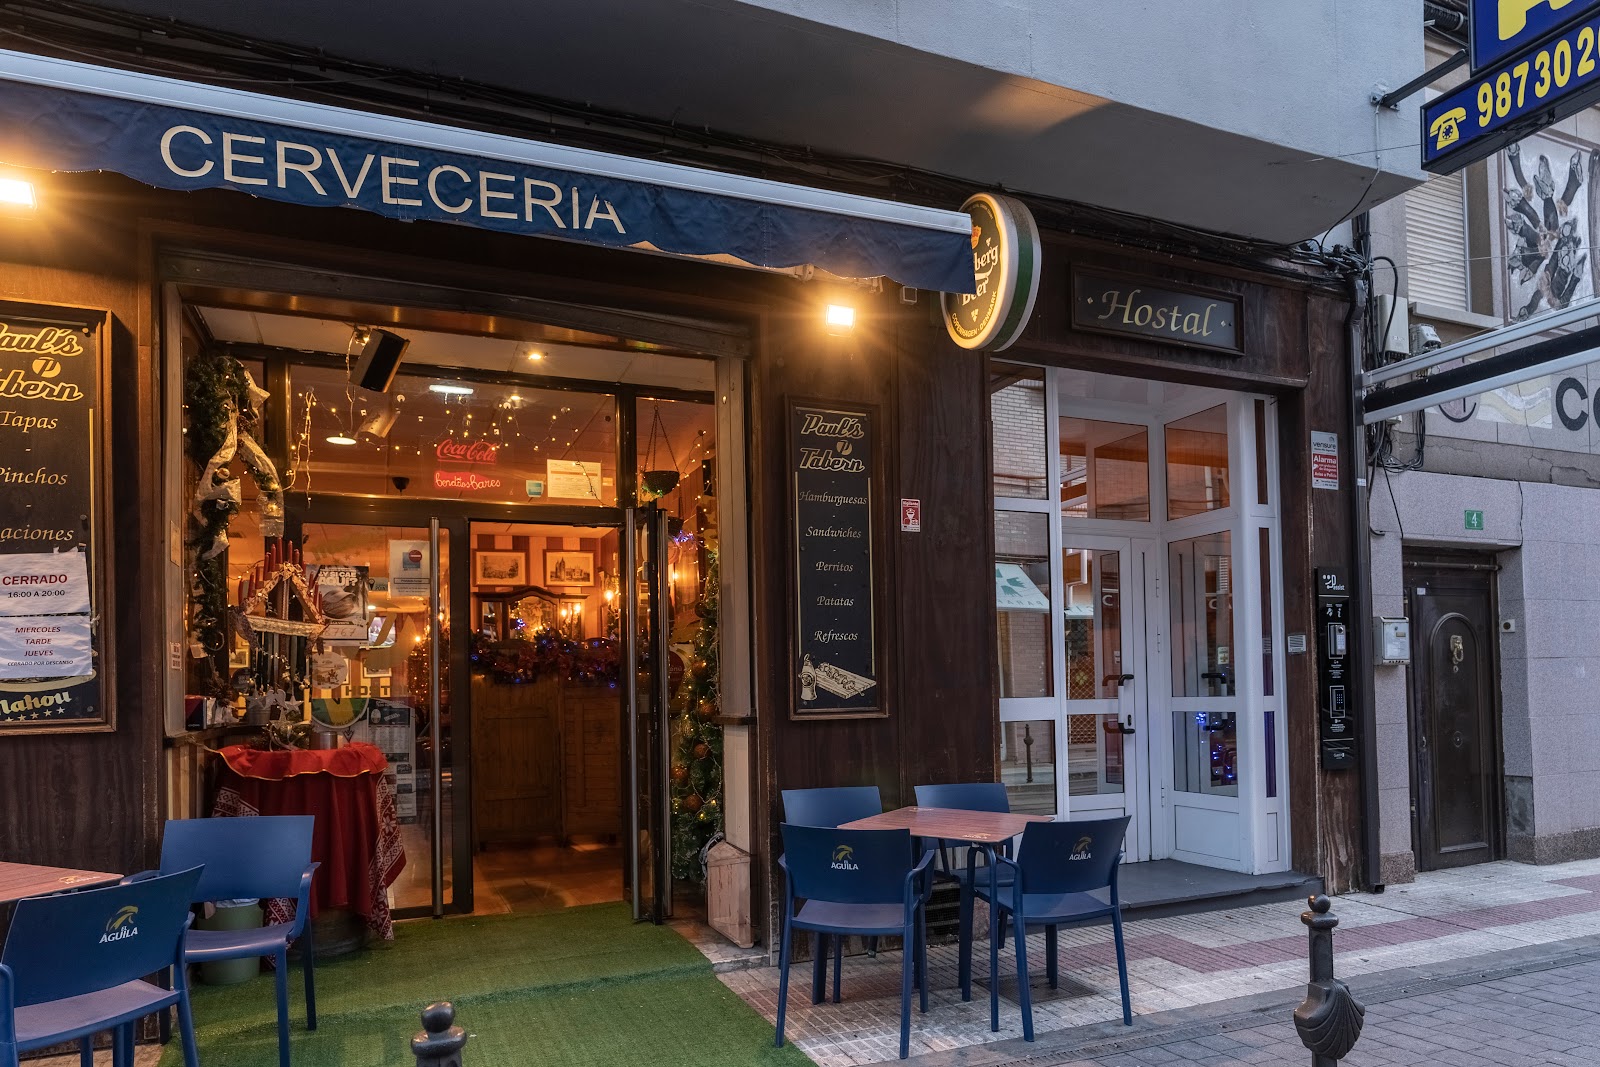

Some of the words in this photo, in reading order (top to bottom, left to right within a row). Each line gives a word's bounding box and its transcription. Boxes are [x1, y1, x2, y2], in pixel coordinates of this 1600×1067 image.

[1477, 26, 1600, 128] 987302
[160, 125, 626, 234] CERVECERIA
[973, 244, 999, 270] berg
[979, 291, 997, 330] DENMARK
[1098, 289, 1217, 337] Hostal
[0, 323, 83, 356] aul's
[0, 370, 84, 401] bern
[1556, 377, 1600, 431] C
[0, 410, 59, 433] Tapas
[437, 439, 497, 461] Coca-Cola
[800, 448, 865, 472] Tabern
[1313, 455, 1337, 464] Alarma
[470, 475, 501, 490] bares
[799, 491, 867, 507] Hamburguesas
[1470, 512, 1478, 528] 4
[0, 523, 74, 543] aciones
[805, 525, 861, 538] Sandwiches
[815, 561, 854, 572] Perritos
[2, 574, 68, 586] CERRADO
[41, 589, 66, 597] 20:00
[816, 595, 854, 606] Patatas
[814, 629, 858, 643] Refrescos
[24, 649, 54, 657] JUEVES
